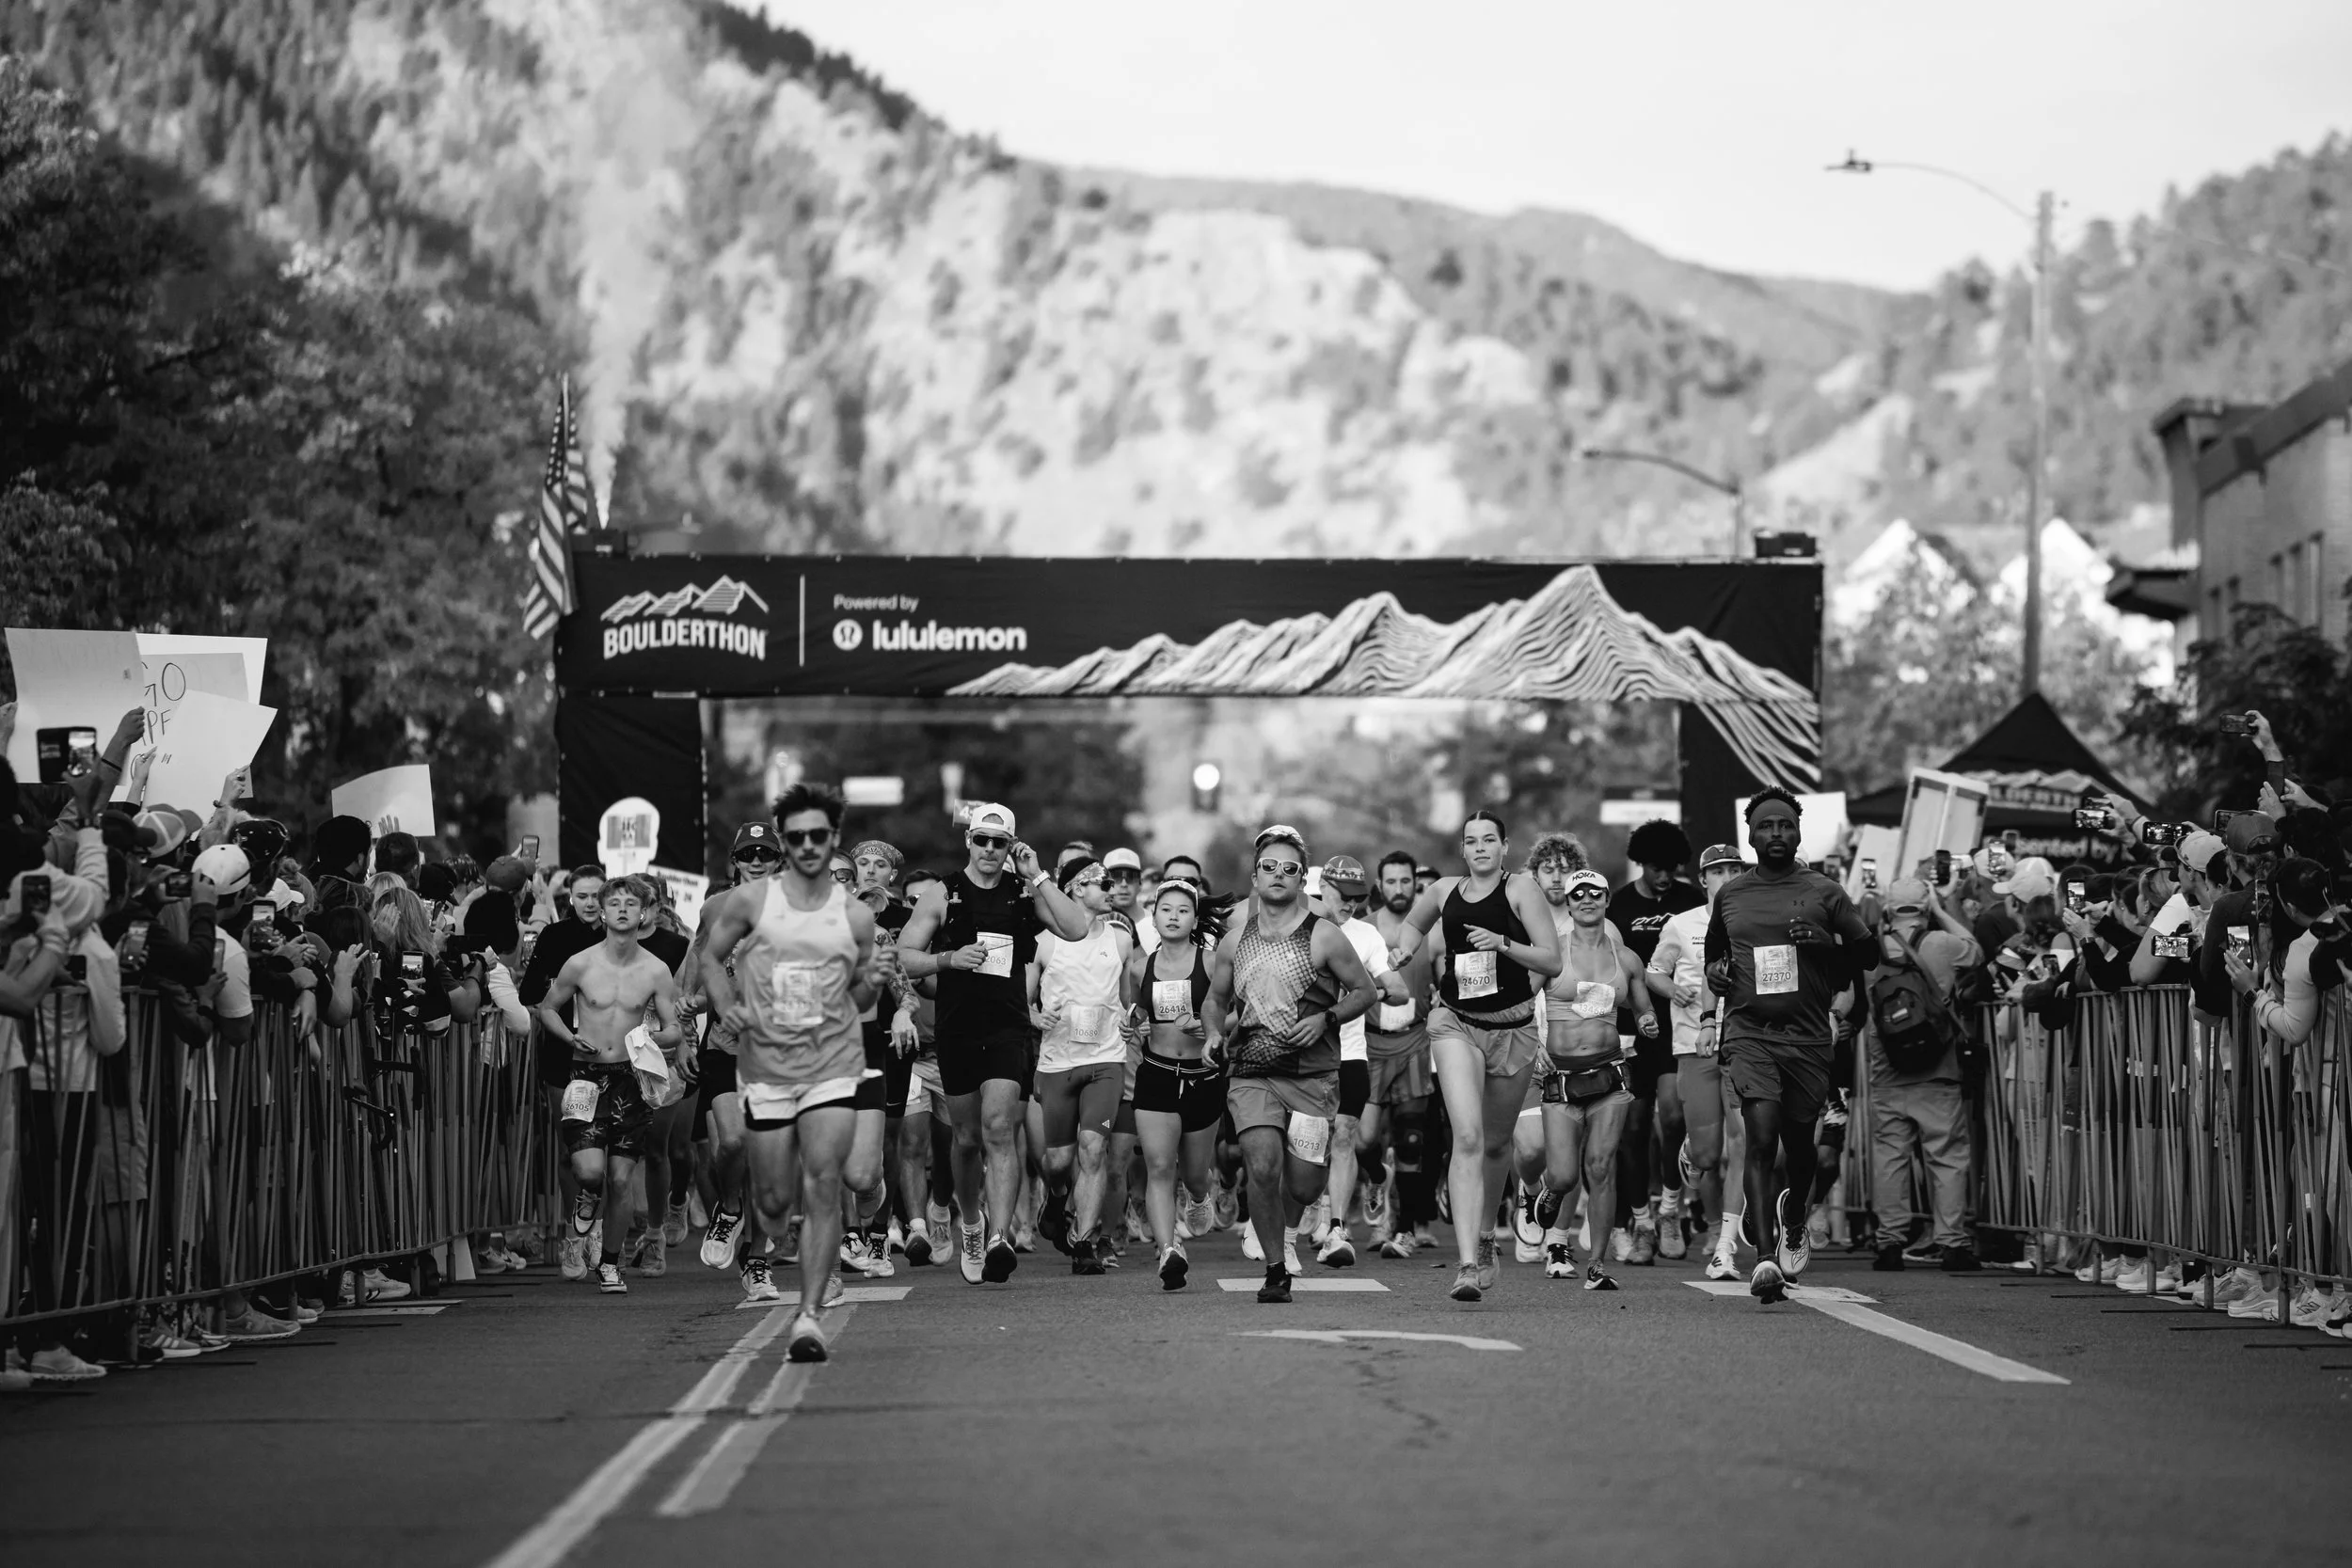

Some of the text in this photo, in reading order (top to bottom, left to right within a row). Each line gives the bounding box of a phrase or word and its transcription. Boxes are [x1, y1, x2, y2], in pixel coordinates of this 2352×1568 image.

[834, 594, 919, 612] Powered by
[603, 618, 766, 660] BOULDERTHON
[872, 619, 1027, 651] lululemon
[1983, 836, 2088, 858] sented
[1572, 872, 1596, 880] HOKA
[985, 956, 1007, 965] 2063
[1462, 975, 1490, 986] 24670
[1762, 972, 1791, 981] 27370
[1159, 1006, 1186, 1014] 26414
[1074, 1028, 1099, 1037] 10689
[565, 1102, 590, 1112] 26105
[1294, 1138, 1320, 1150] 10213
